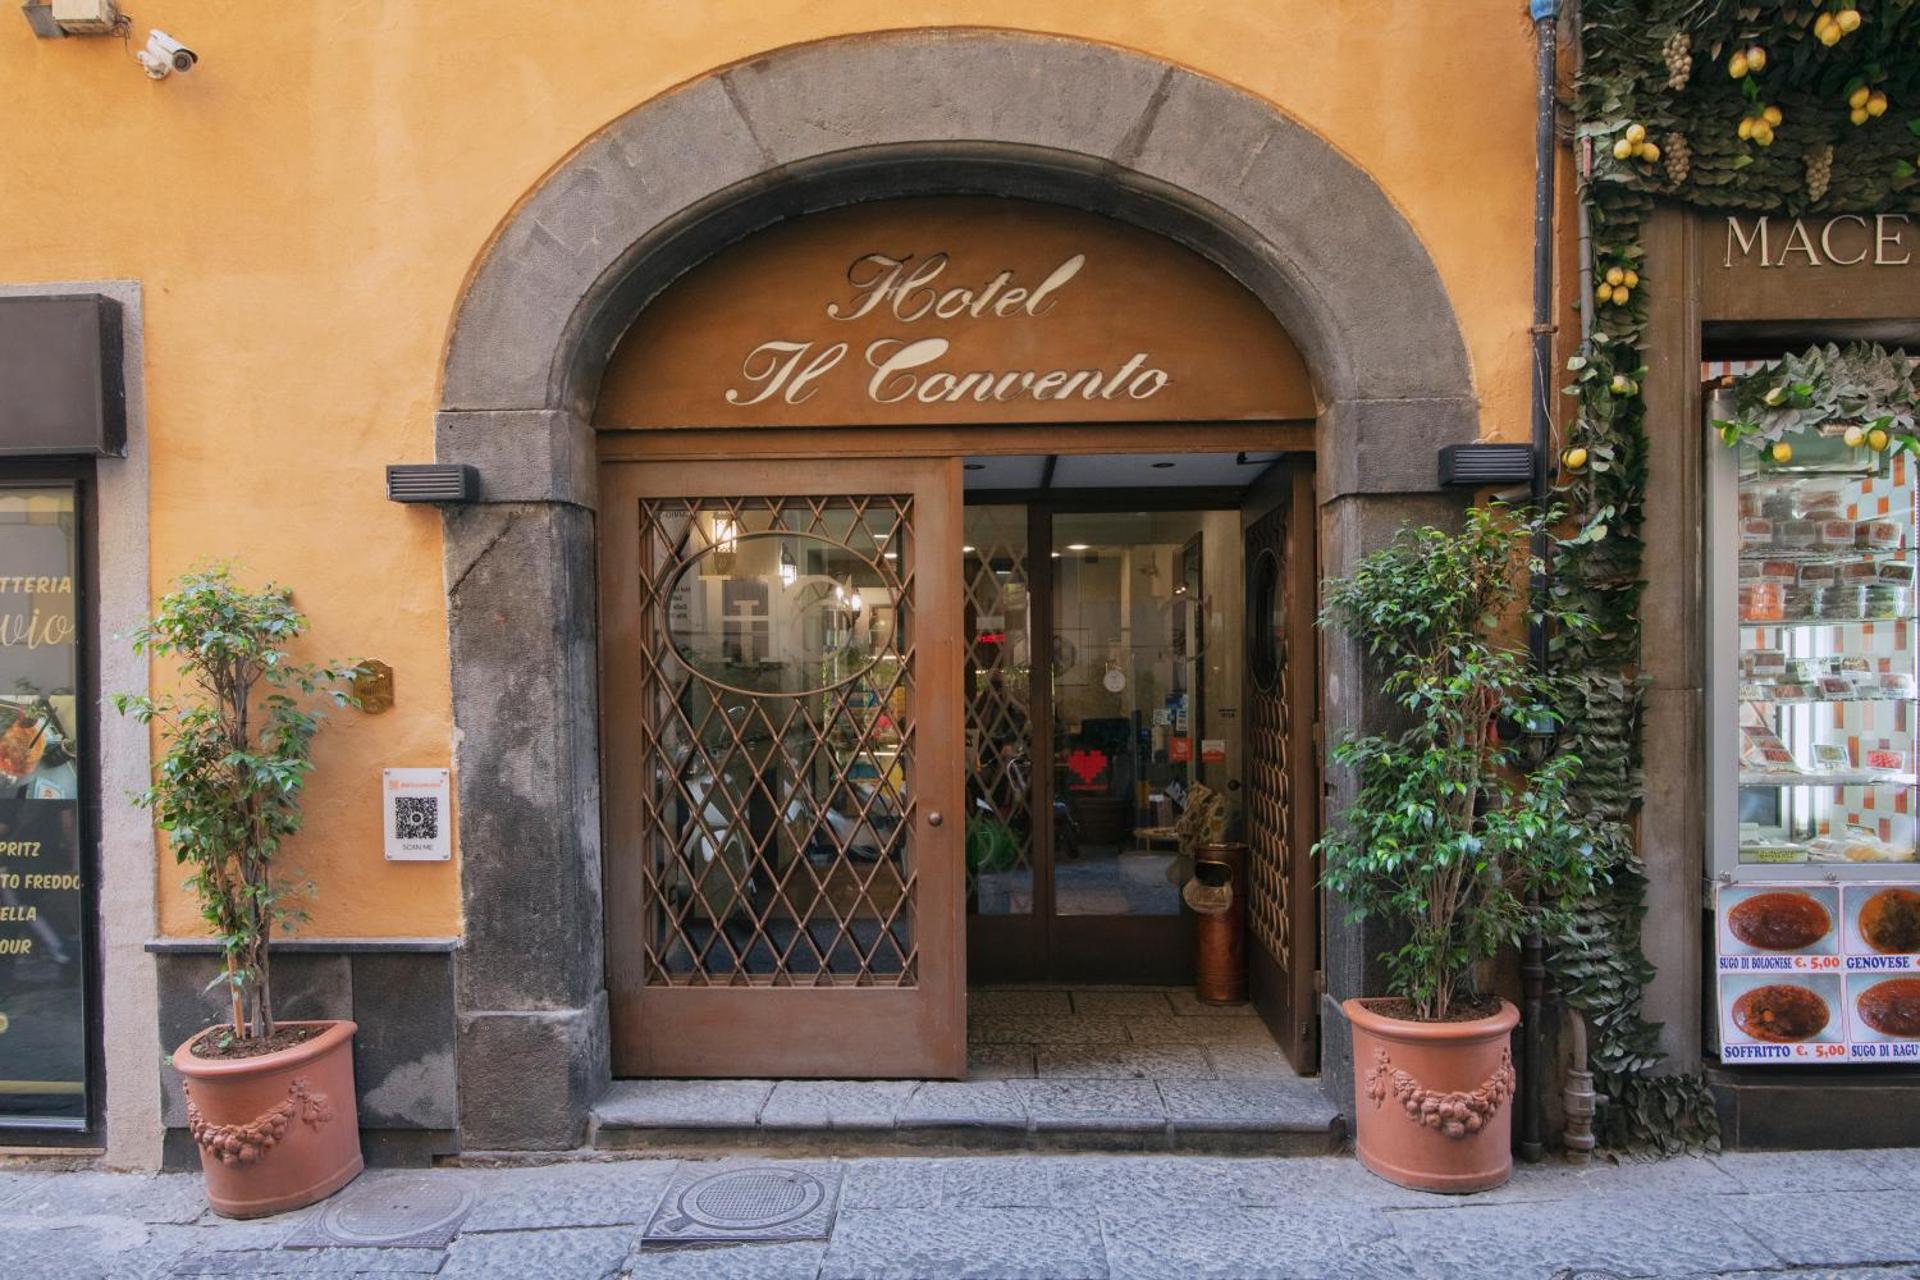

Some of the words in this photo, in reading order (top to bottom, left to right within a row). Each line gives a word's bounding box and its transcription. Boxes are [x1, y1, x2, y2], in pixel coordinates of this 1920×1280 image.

[1723, 214, 1911, 267] MACE
[826, 252, 1087, 322] Hotel
[725, 341, 849, 406] Il
[864, 338, 1172, 404] Convento
[1720, 957, 1739, 969] SUGO
[1741, 957, 1749, 969] DI
[1752, 957, 1792, 969] BOLOGNESE
[1810, 957, 1840, 970] 5,00
[1846, 956, 1910, 969] GENOVESE
[1725, 1046, 1791, 1058] SOFFRITTO
[1815, 1045, 1845, 1058] 5,00
[1851, 1045, 1876, 1057] SUGO
[1879, 1045, 1890, 1057] DI
